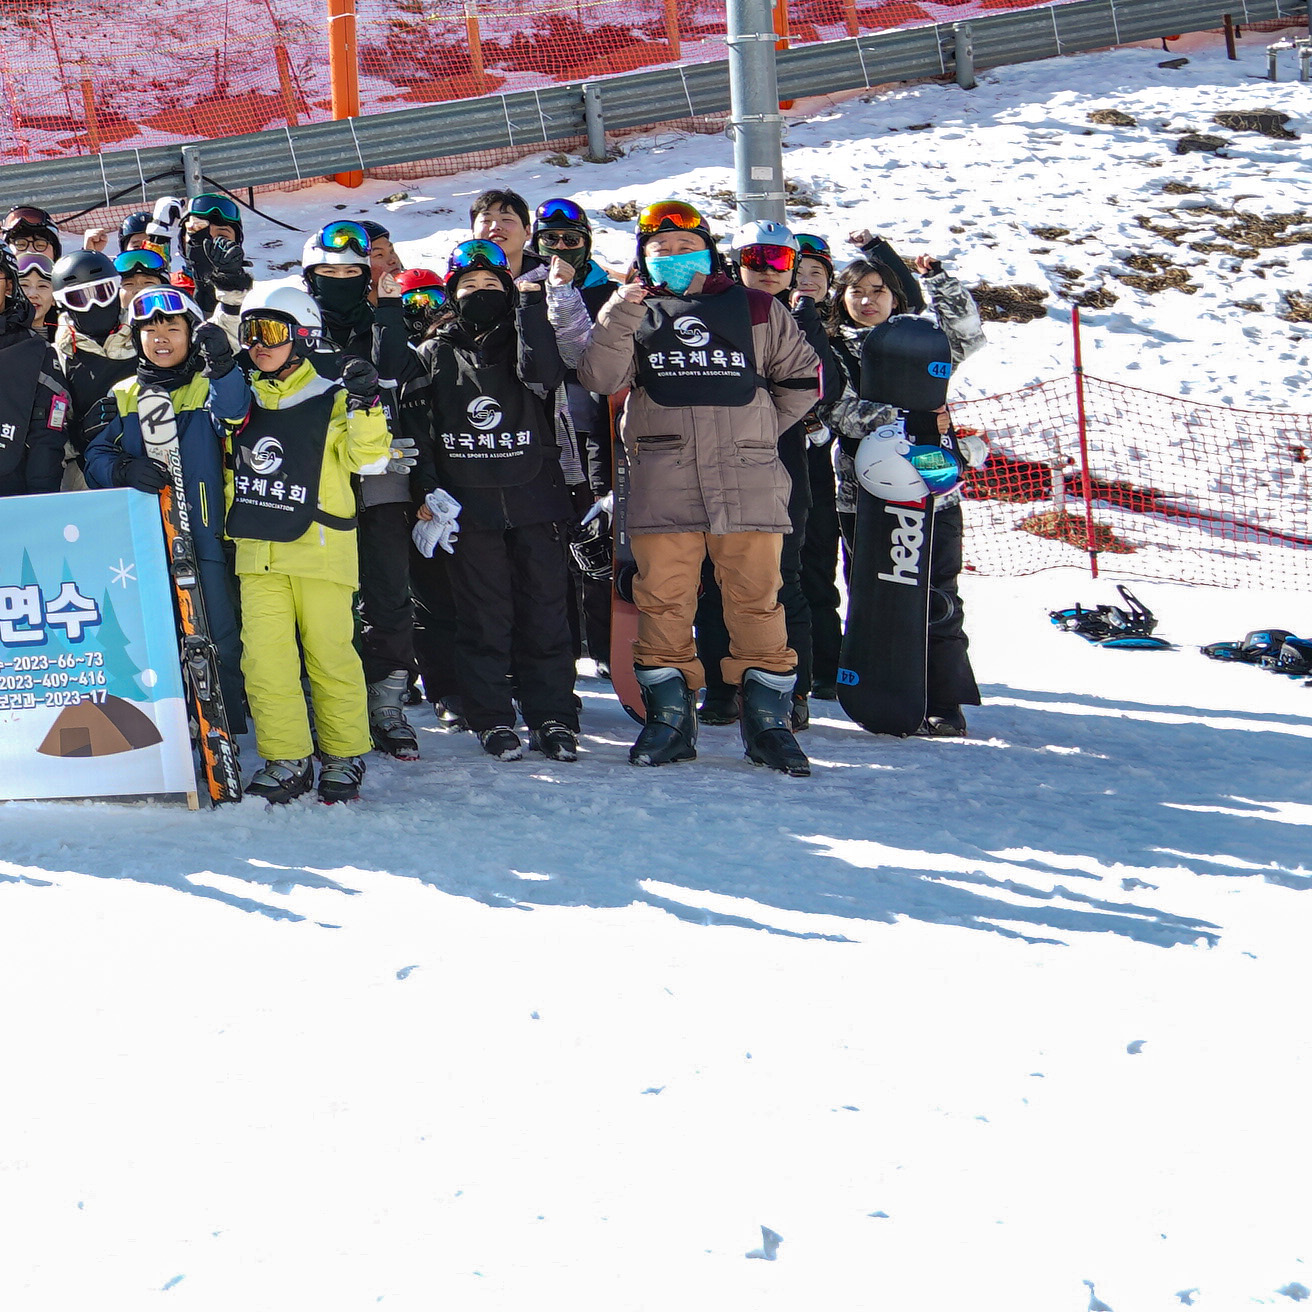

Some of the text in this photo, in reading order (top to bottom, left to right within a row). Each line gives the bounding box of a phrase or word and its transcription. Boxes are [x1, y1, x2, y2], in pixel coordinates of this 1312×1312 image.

[647, 350, 746, 369] 한국체육회
[932, 363, 946, 376] 44
[441, 430, 531, 451] 한국체육회
[489, 450, 524, 458] ASSOCIATION
[169, 447, 191, 533] ROSSIGNOL
[259, 501, 295, 512] ASSOCIATION
[877, 505, 925, 586] head
